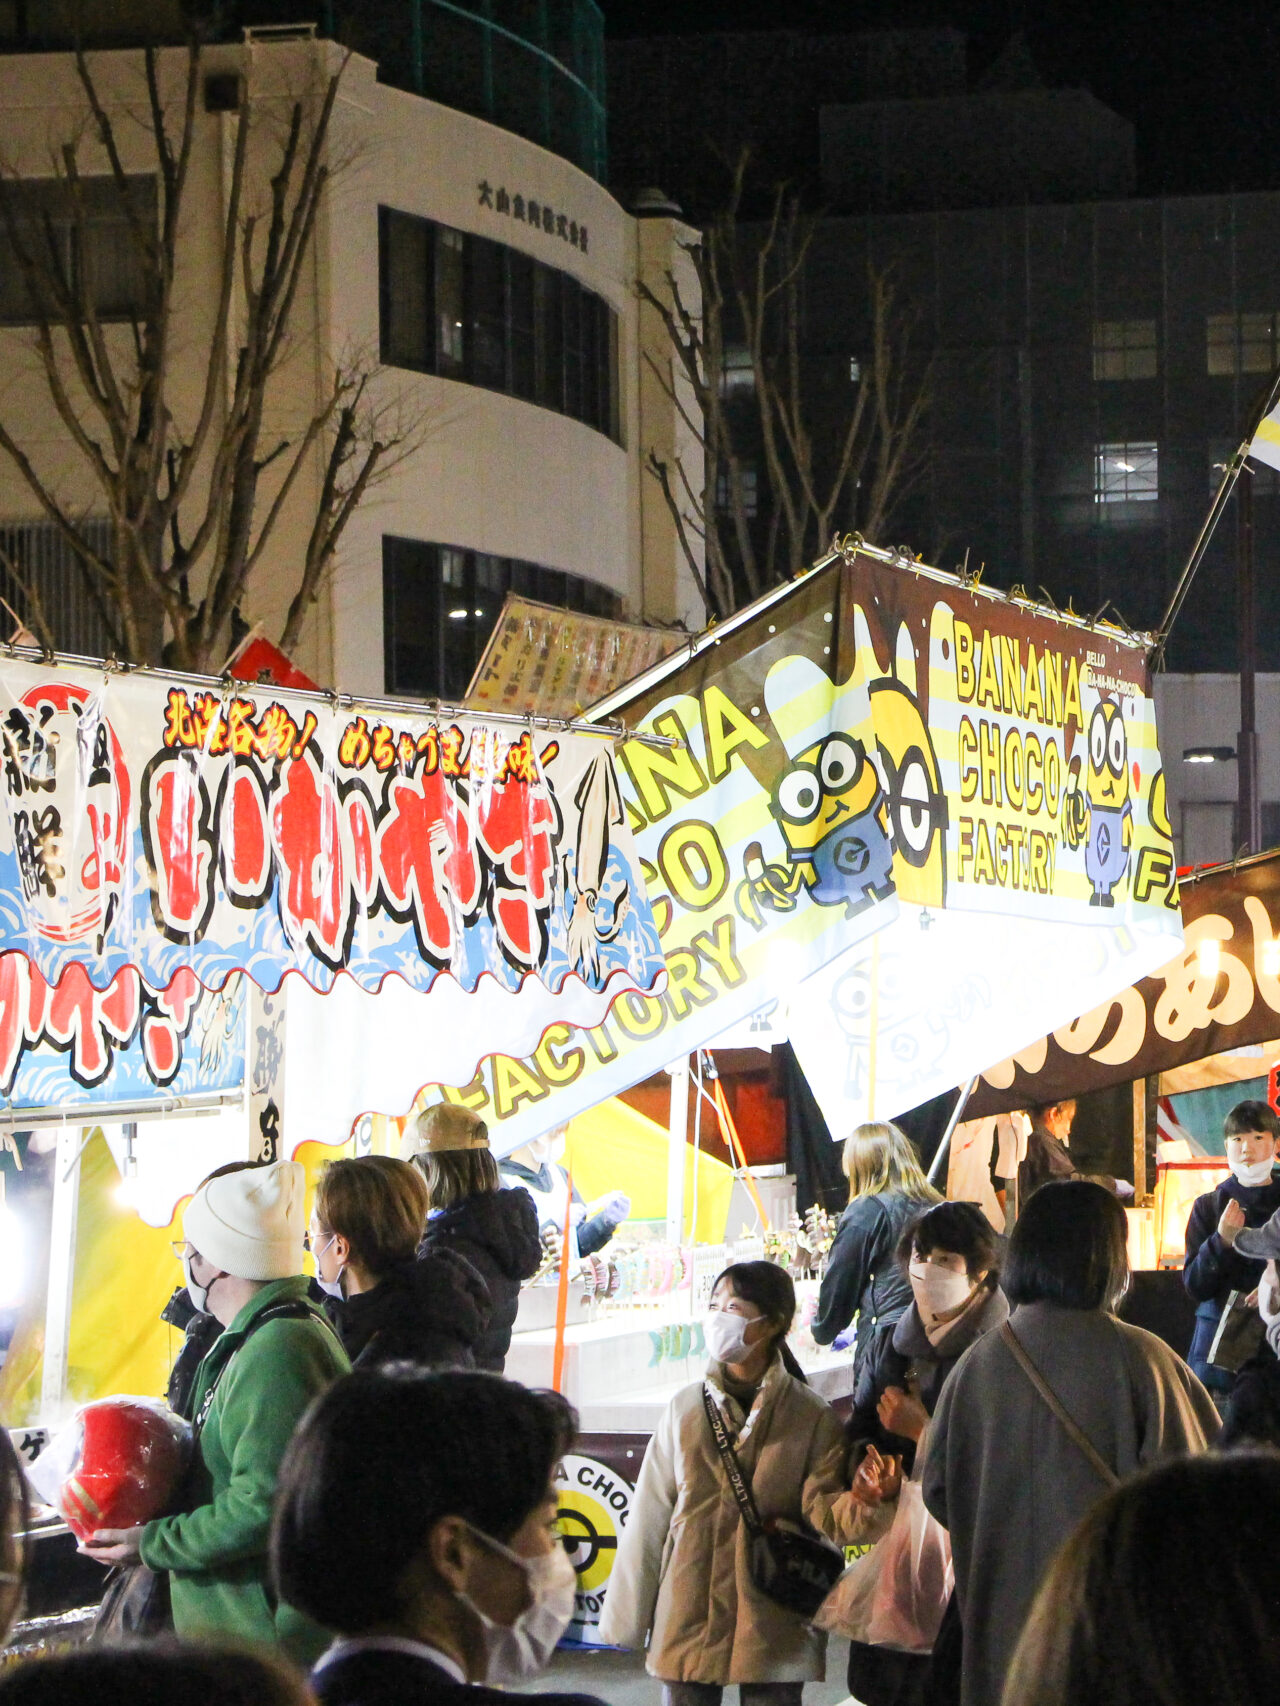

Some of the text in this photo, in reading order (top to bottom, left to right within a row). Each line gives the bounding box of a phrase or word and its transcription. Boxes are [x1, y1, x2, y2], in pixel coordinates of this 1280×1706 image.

[952, 617, 1085, 735] BANANA
[1086, 650, 1106, 668] BELLO
[957, 713, 1063, 819] CHOCO
[141, 740, 561, 974] いかやき
[957, 815, 1059, 896] FACTORY
